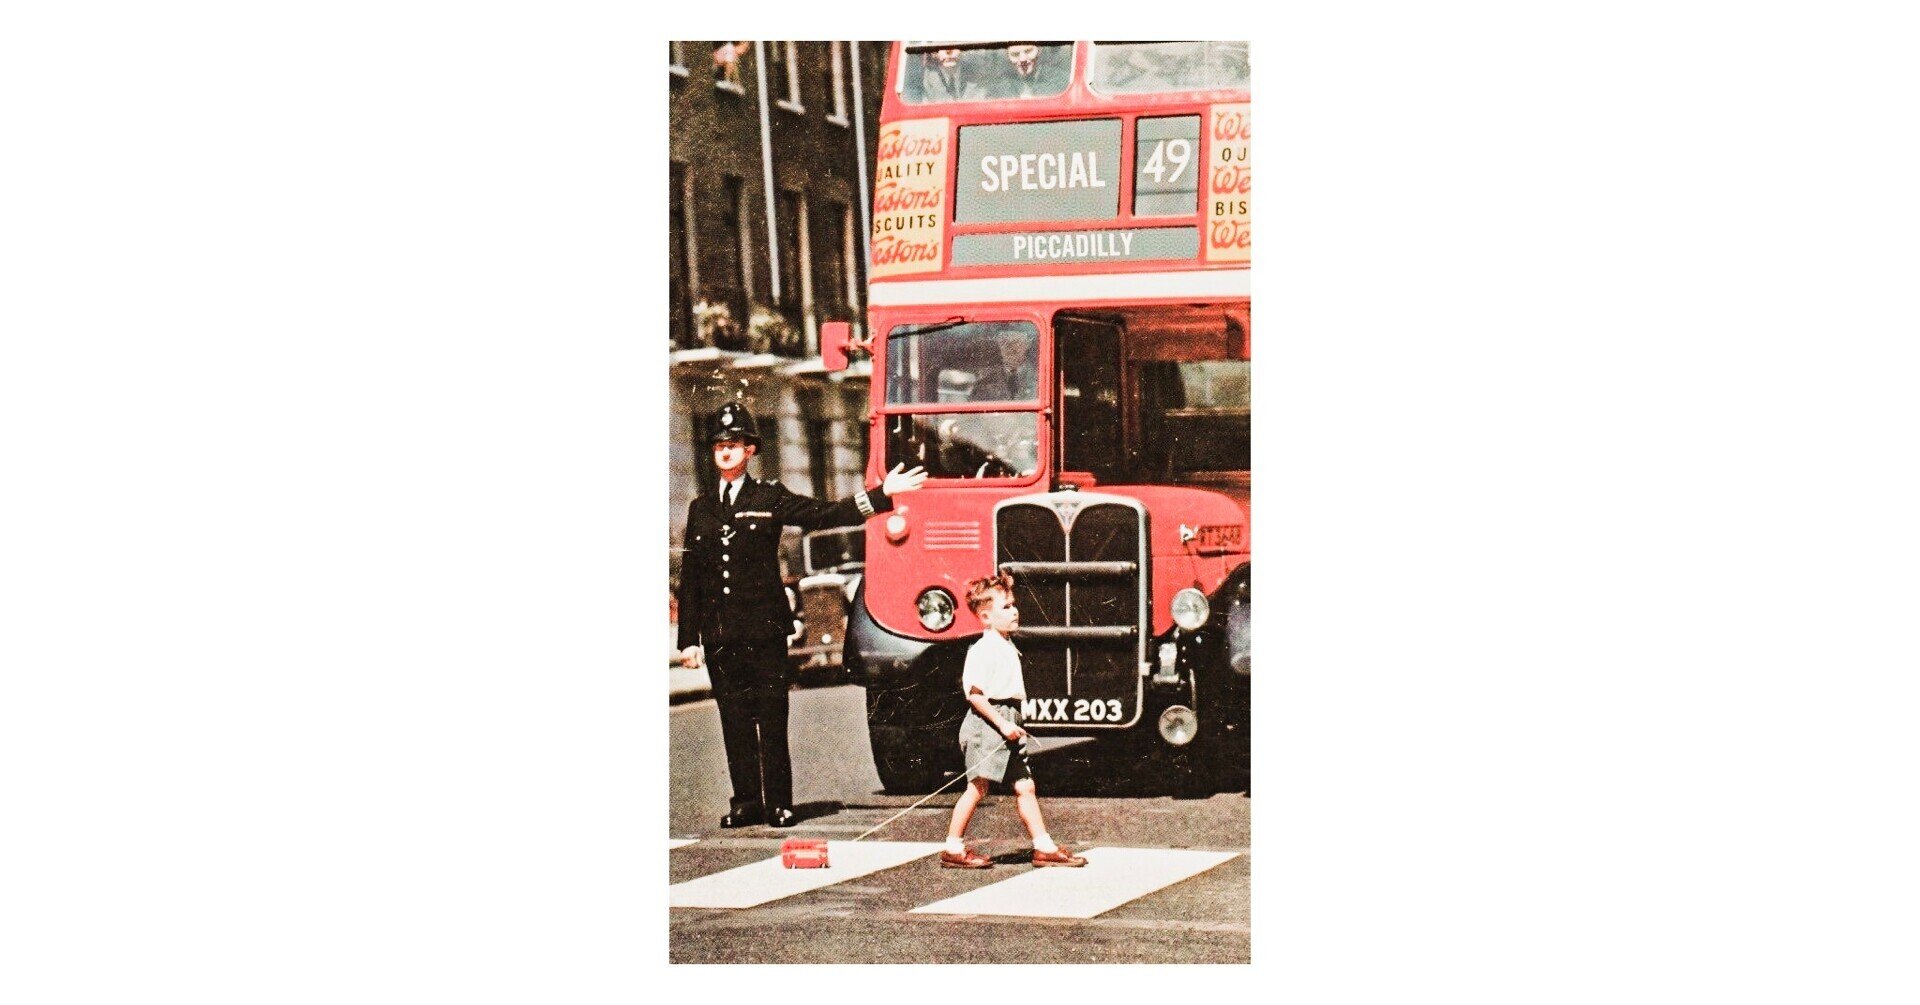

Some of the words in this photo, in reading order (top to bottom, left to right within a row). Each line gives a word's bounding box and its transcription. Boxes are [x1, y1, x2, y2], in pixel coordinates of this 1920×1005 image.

[981, 151, 1106, 192] SPECIAL
[1142, 139, 1191, 183] 49
[1215, 201, 1247, 215] BIS
[875, 214, 936, 233] SCUITS
[1013, 233, 1133, 259] PICCADILLY
[1020, 698, 1069, 721] MXX
[1073, 698, 1122, 721] 203
